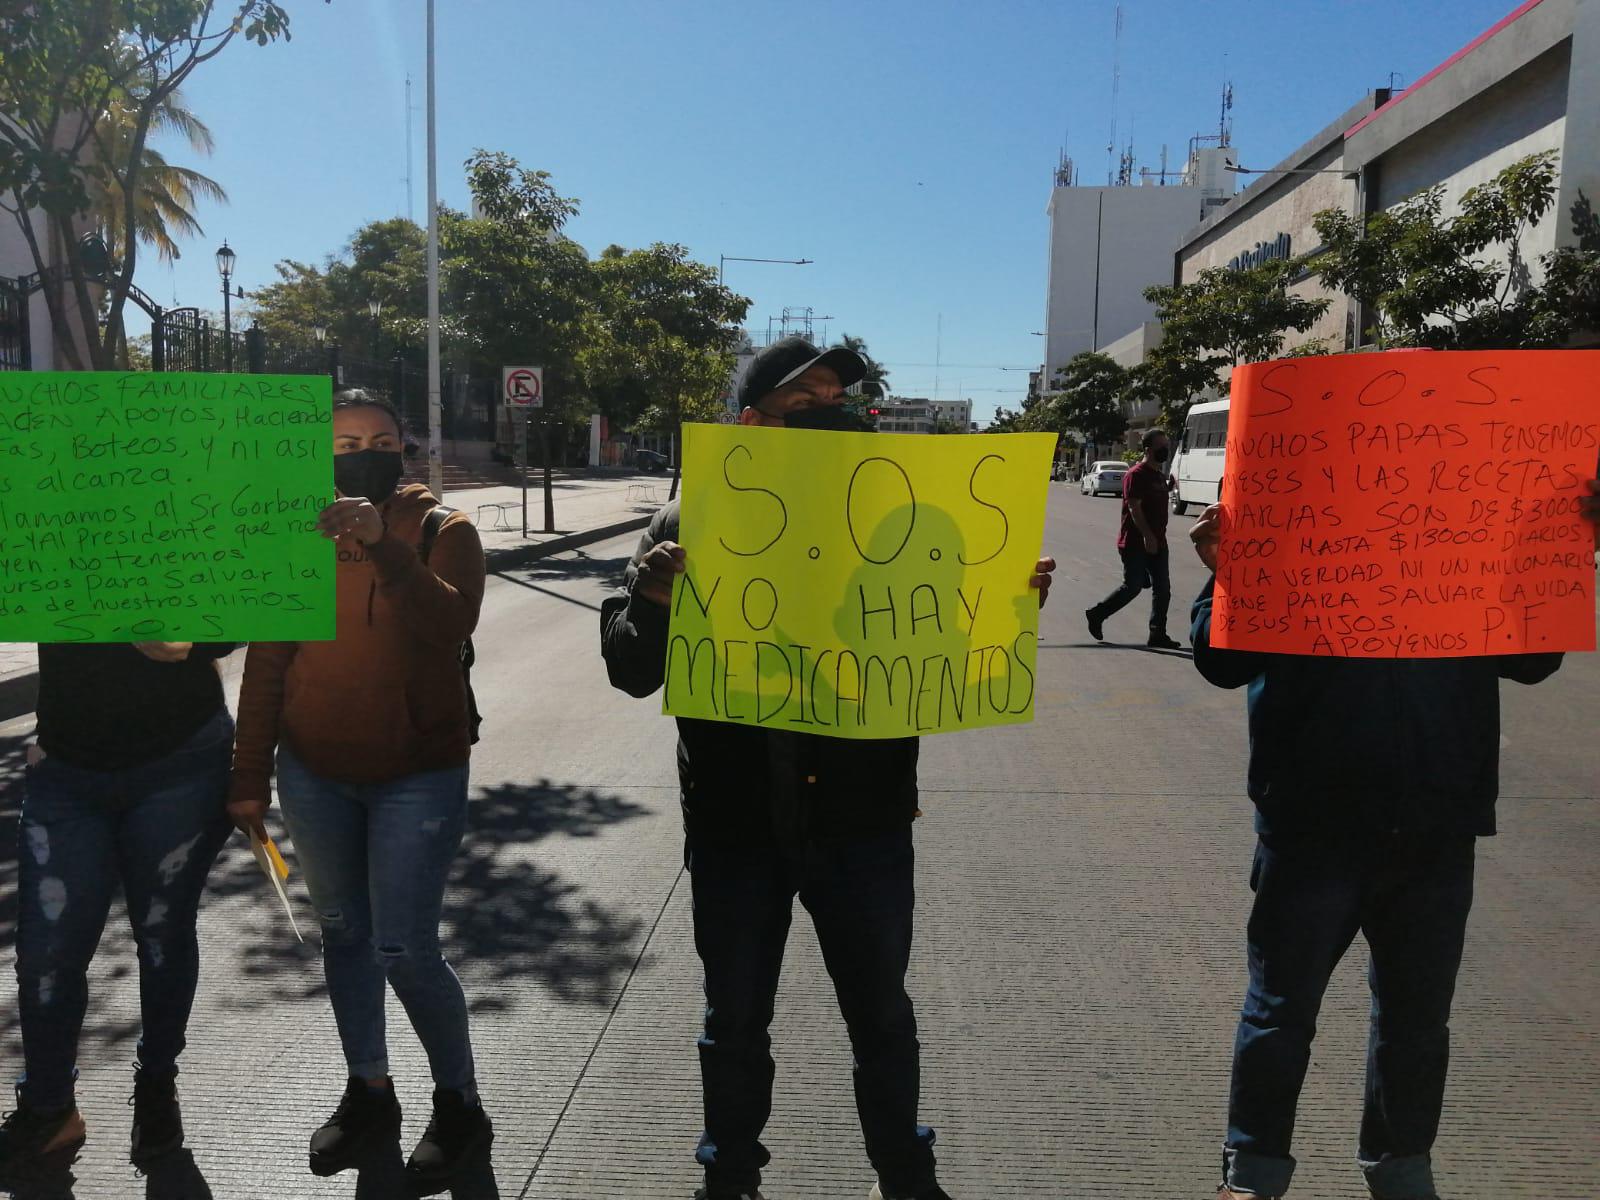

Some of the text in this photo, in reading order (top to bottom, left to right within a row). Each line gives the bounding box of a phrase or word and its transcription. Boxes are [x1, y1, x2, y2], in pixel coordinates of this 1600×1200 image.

[0, 373, 316, 408] UCHOS FAMILIARES
[0, 405, 73, 432] ACEN
[235, 404, 332, 429] Haciendo
[1226, 420, 1598, 463] MUCHOS PAPAS TENEMOS
[1223, 458, 1579, 495] MESES Y LAS RECETAS
[0, 499, 137, 532] lamamos
[191, 493, 222, 523] Sr
[1366, 501, 1448, 532] SON
[1466, 499, 1499, 526] DE
[234, 519, 278, 549] que
[1300, 535, 1372, 557] HASTA
[0, 558, 57, 577] yen.
[105, 549, 246, 569] tenemos
[0, 577, 73, 594] ursos
[289, 562, 322, 580] la
[1242, 567, 1273, 588] LA
[1282, 563, 1383, 588] VERDAD
[1401, 559, 1424, 579] NI
[1440, 557, 1470, 576] UN
[1480, 550, 1596, 577] MILLONARIO
[0, 597, 27, 617] da
[46, 596, 78, 612] de
[93, 592, 198, 611] nuestros
[675, 573, 983, 640] NO HAY
[1218, 579, 1587, 618] TIENE PARA SALVAR LA VIDA
[1218, 614, 1237, 632] DE
[1247, 615, 1291, 634] SUS
[1312, 631, 1468, 658] APOYENOS
[665, 631, 1035, 732] MEDICAMENTOS
